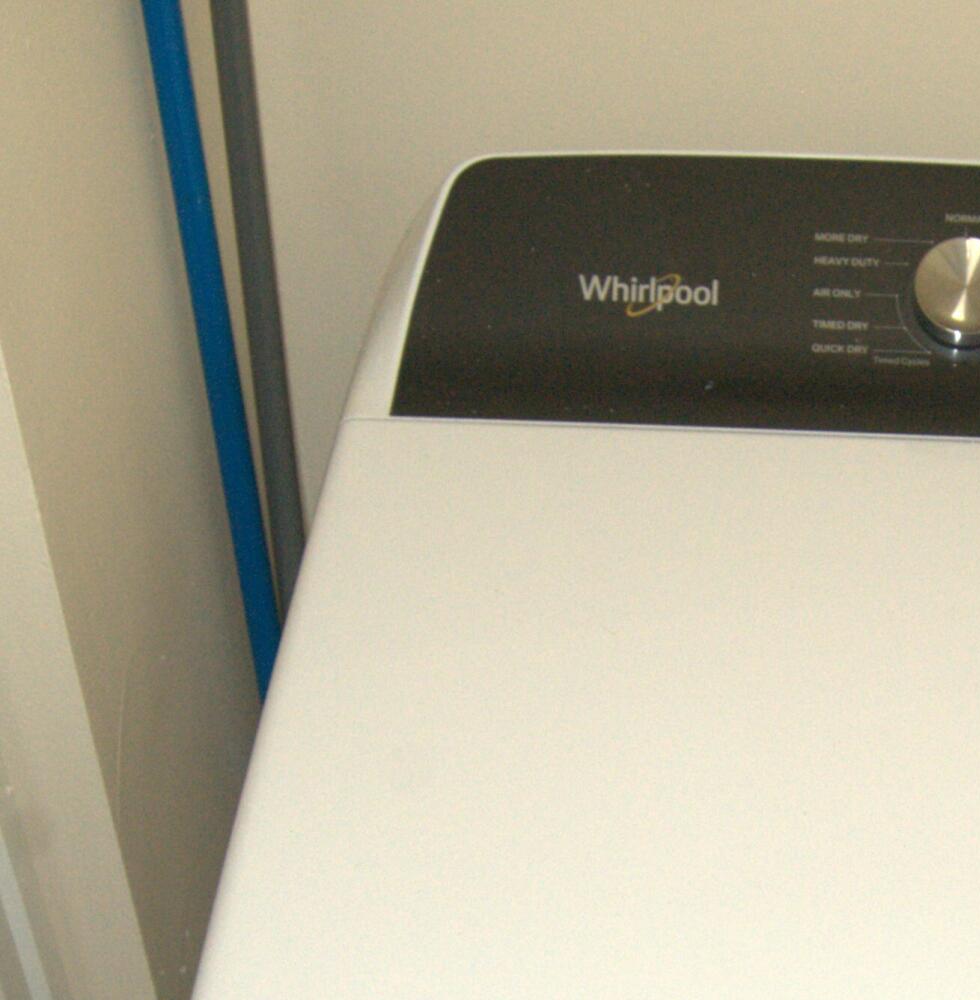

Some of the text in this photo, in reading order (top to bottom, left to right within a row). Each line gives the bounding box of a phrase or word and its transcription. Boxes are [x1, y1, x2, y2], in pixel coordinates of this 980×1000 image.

[814, 232, 870, 243] MORE DRY
[813, 256, 879, 267] HEAVY DUTY
[578, 274, 720, 312] Whirlpool
[812, 288, 862, 298] AIR ONLY
[812, 320, 870, 330] TIMED DRY
[811, 343, 869, 354] QUICK DRY
